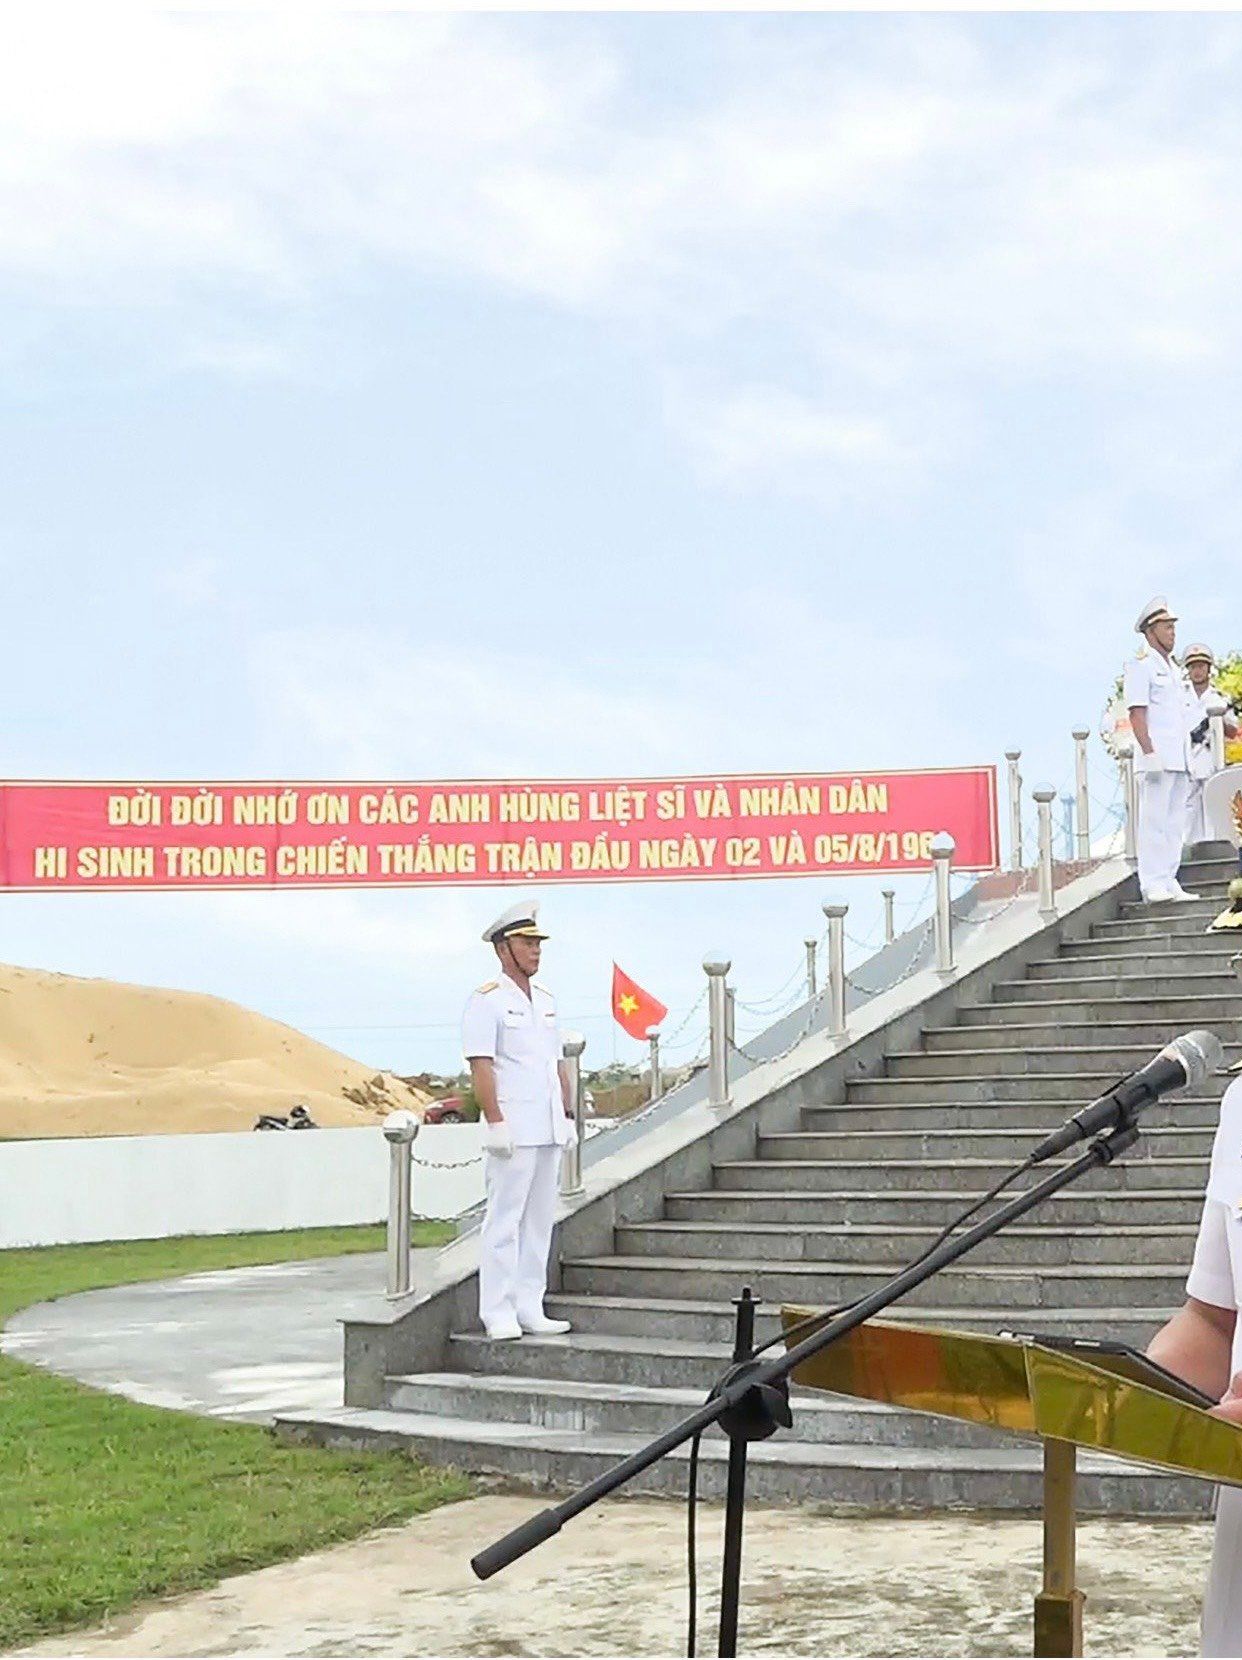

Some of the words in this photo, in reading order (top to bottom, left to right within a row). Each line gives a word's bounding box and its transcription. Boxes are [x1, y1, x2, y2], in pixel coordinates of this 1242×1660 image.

[108, 787, 162, 826] ĐỜI
[170, 787, 223, 826] ĐỜI
[233, 788, 299, 825] NHỚ
[306, 792, 350, 825] ƠN
[358, 788, 419, 825] CÁC
[428, 793, 491, 824] ANH
[499, 786, 581, 823] HÙNG
[588, 784, 649, 828] LIỆT
[656, 784, 686, 820] SĨ
[693, 782, 732, 818] VÀ
[739, 780, 821, 817] NHÂN
[828, 778, 888, 815] DÂN
[34, 847, 68, 878] HI
[76, 846, 154, 879] SINH
[162, 846, 267, 877] TRONG
[275, 835, 369, 876] CHIẾN
[376, 833, 477, 875] THẮNG
[484, 836, 563, 878] TRẬN
[638, 832, 718, 870] NGÀY
[725, 837, 761, 867] 02
[768, 829, 807, 866] VÀ
[814, 831, 935, 865] 05/8/196
